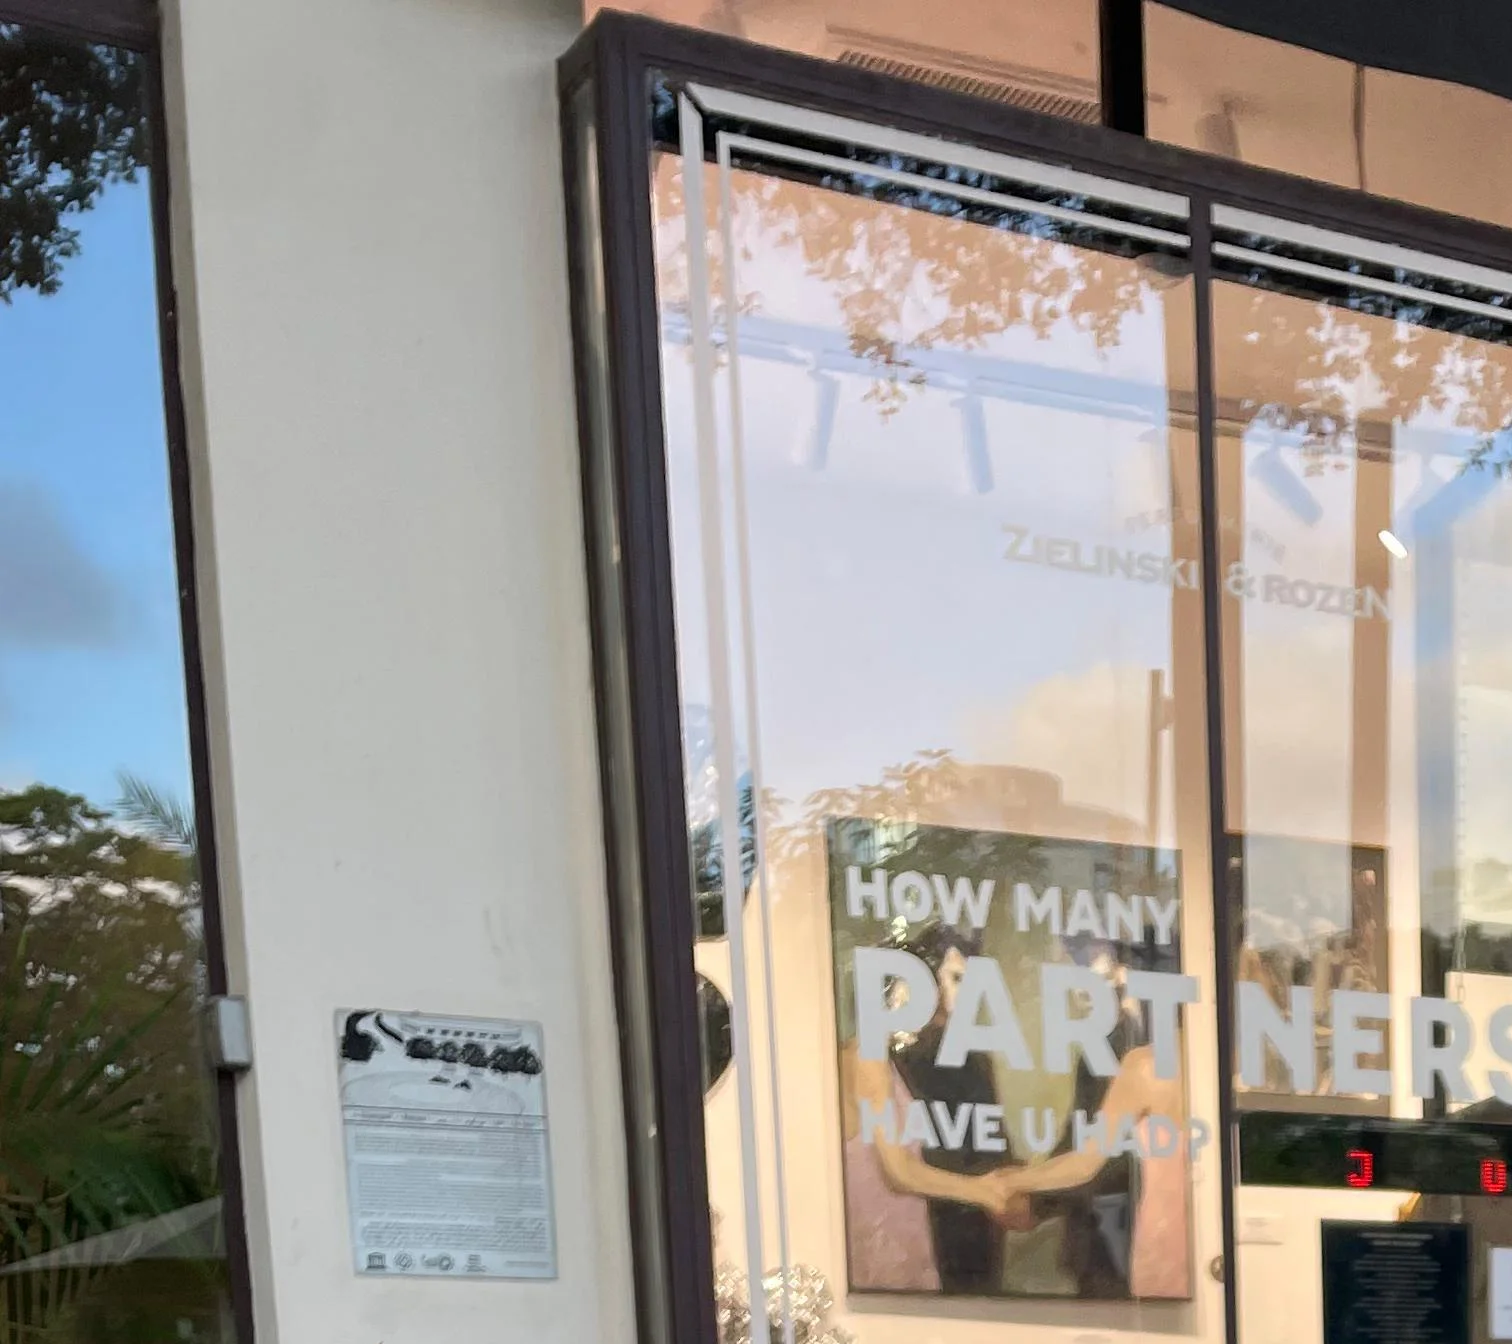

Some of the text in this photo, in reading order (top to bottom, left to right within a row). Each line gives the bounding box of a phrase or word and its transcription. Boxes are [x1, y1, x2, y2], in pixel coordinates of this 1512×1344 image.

[1001, 525, 1200, 591] ZIELINSKI
[1224, 561, 1256, 599] &
[1262, 574, 1391, 621] ROZEN
[845, 865, 1179, 945] HOW MANY
[857, 1099, 1211, 1163] HAVE U HAD?
